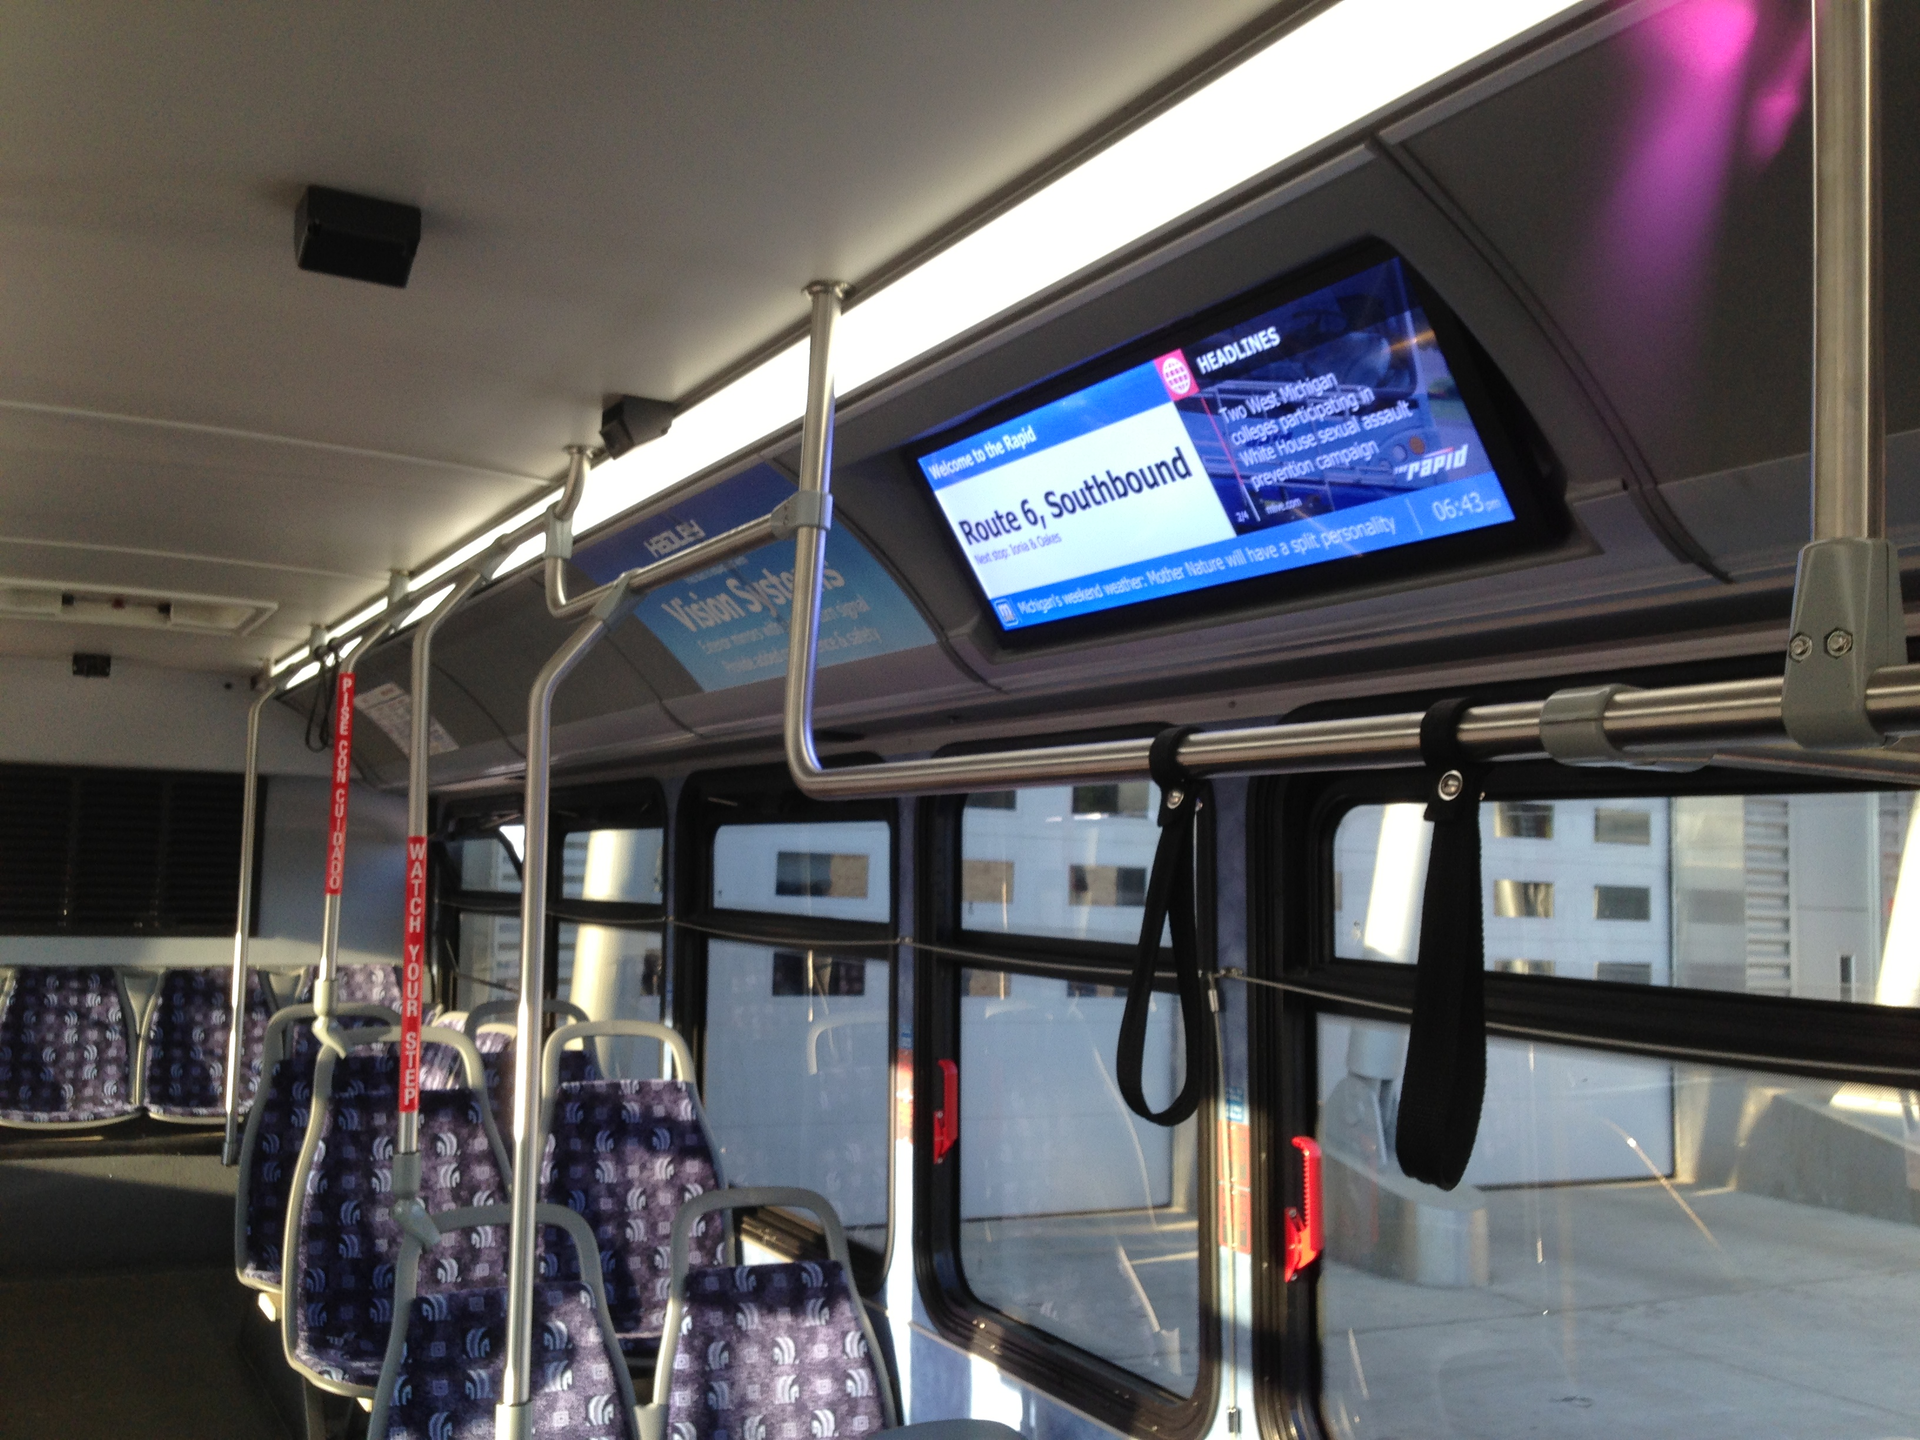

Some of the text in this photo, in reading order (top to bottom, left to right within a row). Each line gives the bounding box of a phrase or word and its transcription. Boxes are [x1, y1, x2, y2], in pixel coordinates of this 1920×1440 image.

[1196, 326, 1281, 375] HEADLINES
[1218, 372, 1338, 423] Two West Michigan
[1231, 386, 1376, 446] colleges participating in
[928, 425, 1038, 480] Welcome to the Rapid
[1238, 399, 1414, 467] White House sexual assault
[958, 446, 1194, 546] Route 6, Southbound
[1251, 439, 1381, 493] prevention campaign
[1432, 491, 1485, 521] 06:43
[974, 553, 993, 566] Next
[991, 548, 1011, 561] stop:
[1036, 533, 1063, 548] Oakes
[1017, 516, 1397, 614] Michigan's weekend weather: Mother Nature will have a split personality
[661, 591, 746, 633] Vision
[725, 563, 846, 617] Systes
[329, 677, 353, 889] PISE CON CUIDADO
[403, 843, 425, 1106] WATCH YOUR STEP
